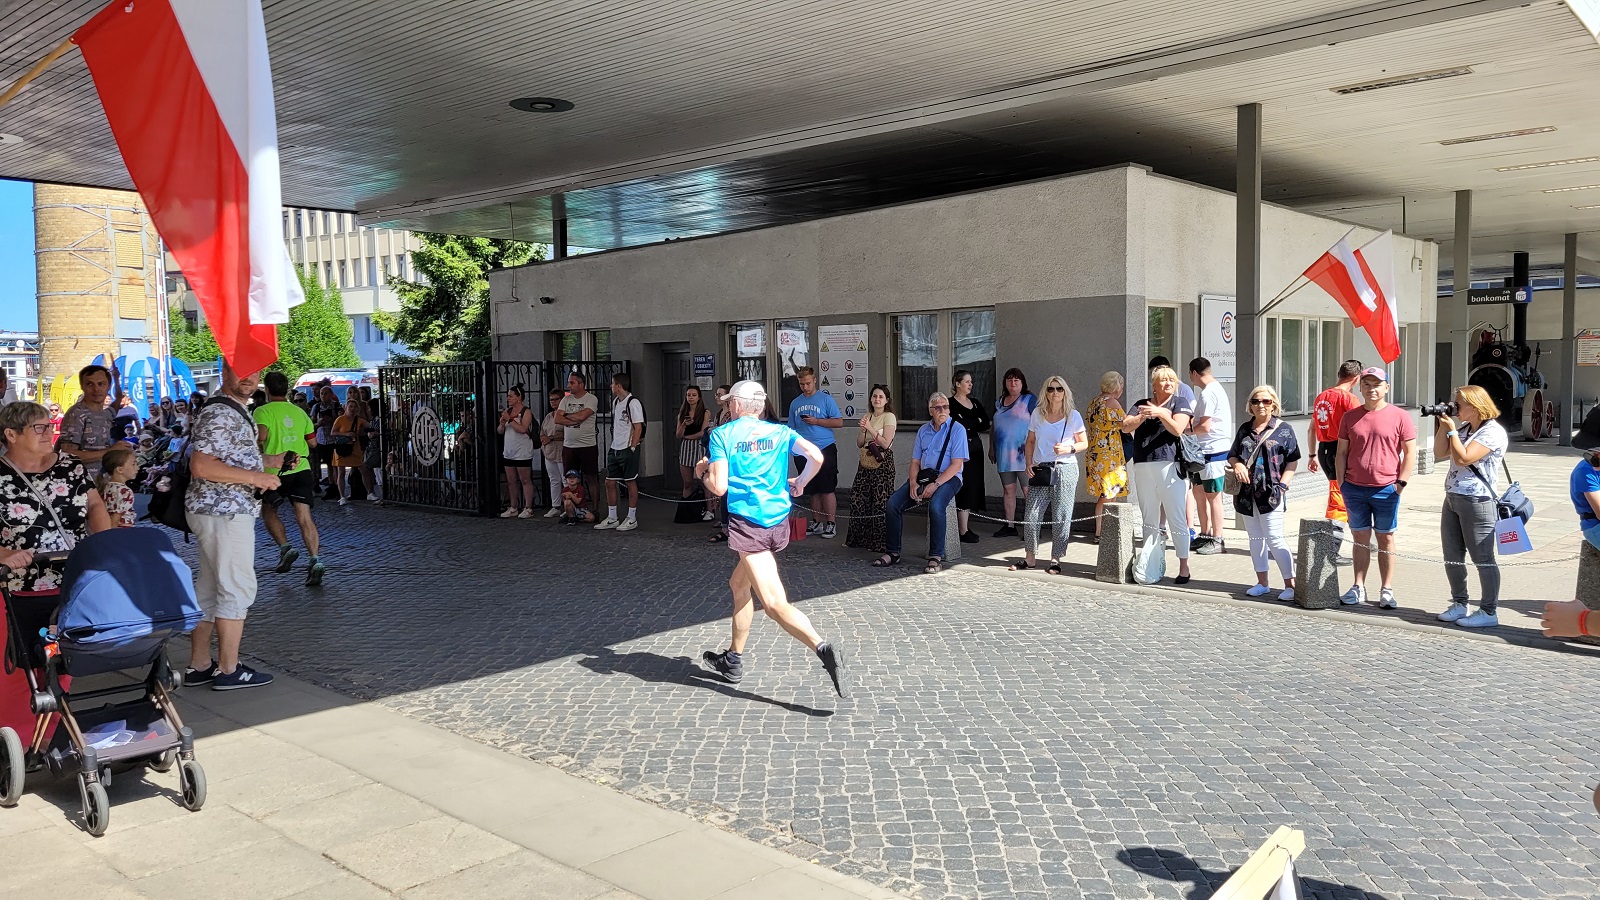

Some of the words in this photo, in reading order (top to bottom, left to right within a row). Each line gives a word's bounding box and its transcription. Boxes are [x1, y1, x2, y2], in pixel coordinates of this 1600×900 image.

[1471, 294, 1510, 303] bankomat
[136, 376, 144, 400] Enea
[1508, 531, 1518, 540] 56
[238, 671, 253, 682] N
